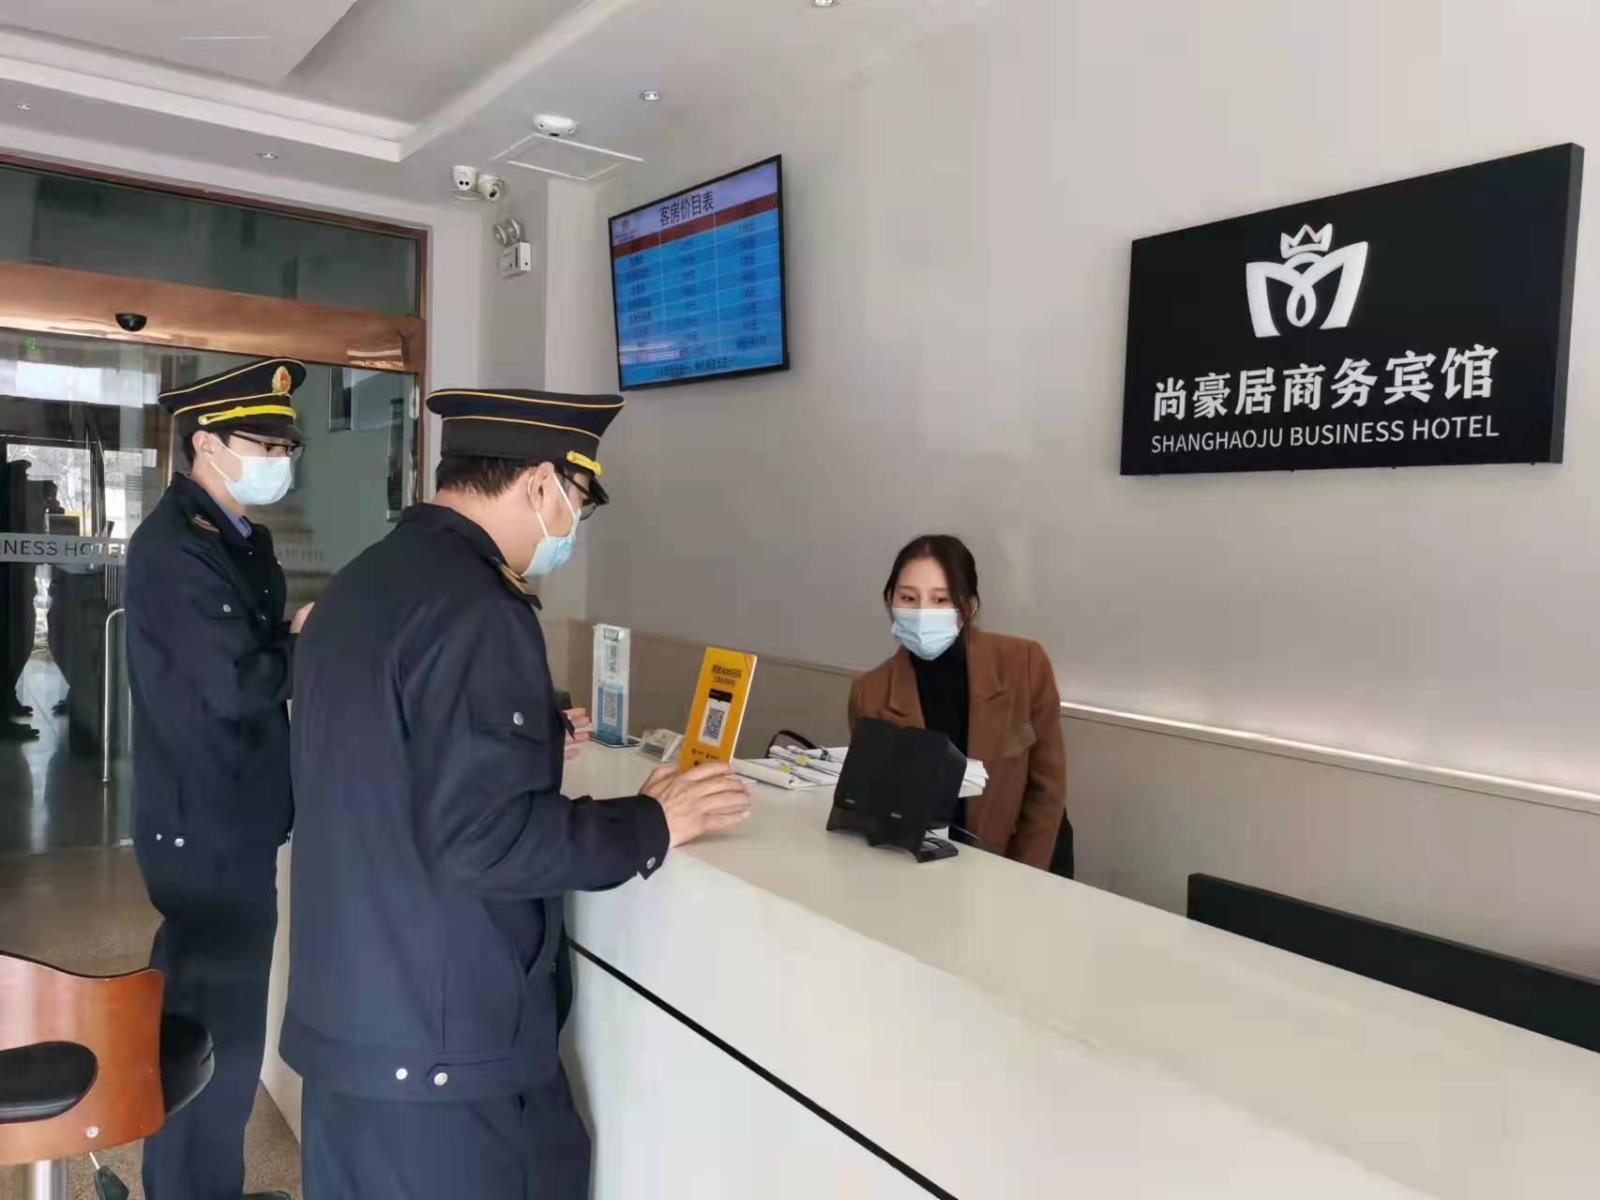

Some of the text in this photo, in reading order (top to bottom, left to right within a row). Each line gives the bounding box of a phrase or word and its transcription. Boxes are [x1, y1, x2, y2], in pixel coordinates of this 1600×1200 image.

[660, 191, 714, 226] 客房价目表
[1153, 343, 1499, 422] 尚豪居商务宾馆
[1151, 415, 1499, 454] SHANGHAOJU BUSINESS HOTEL
[0, 540, 58, 556] NESS
